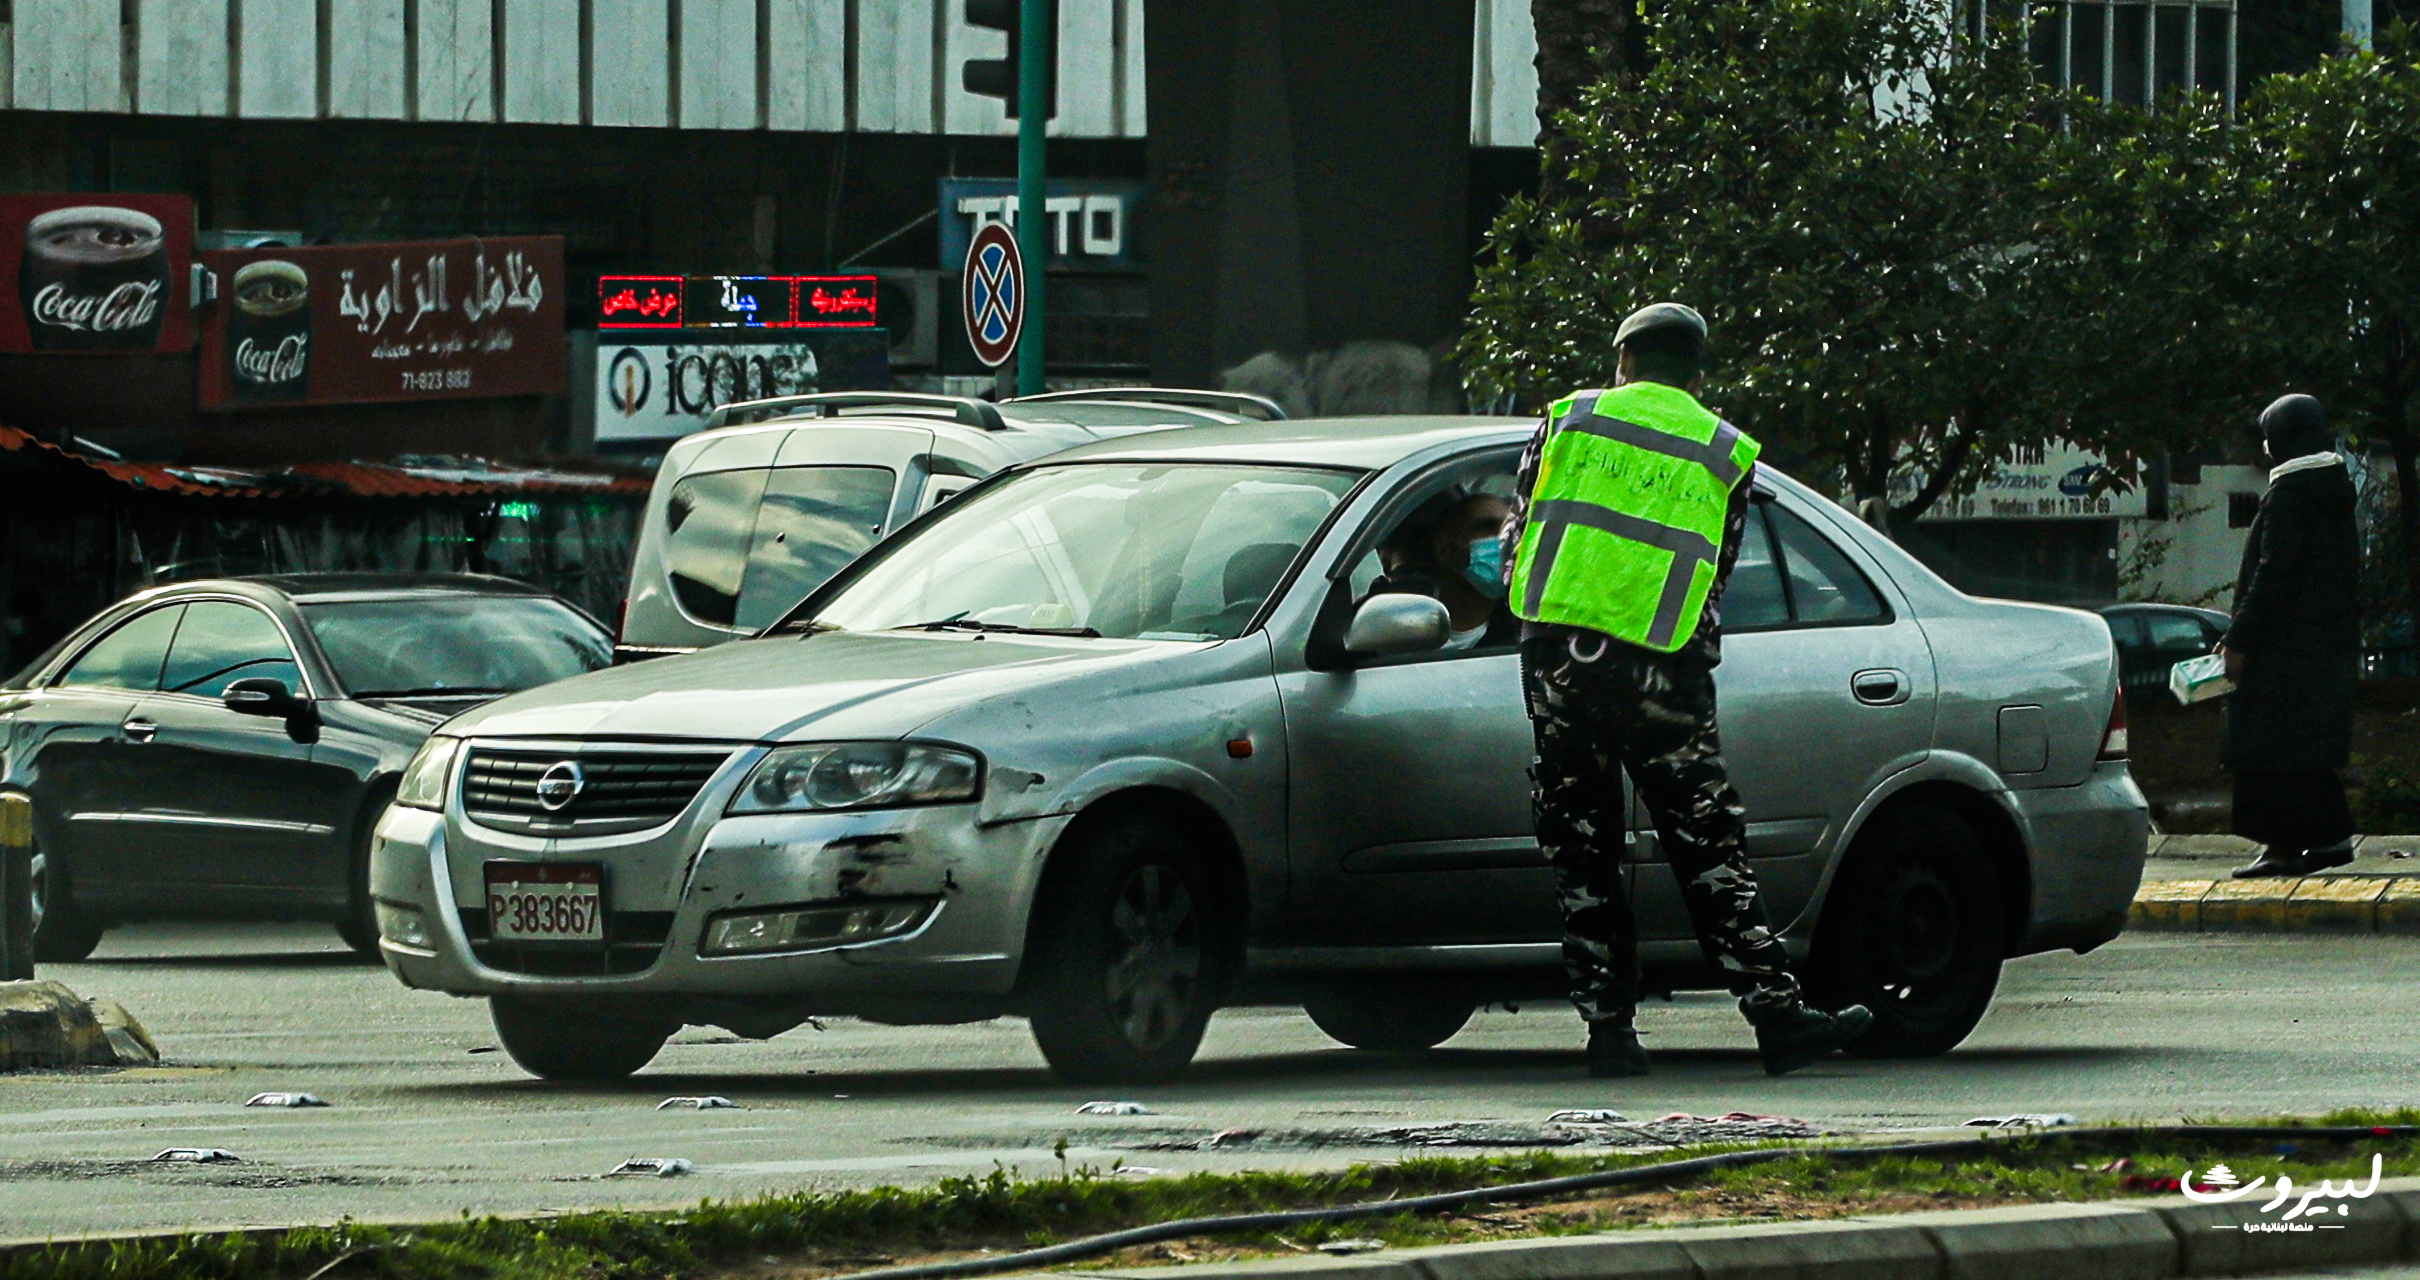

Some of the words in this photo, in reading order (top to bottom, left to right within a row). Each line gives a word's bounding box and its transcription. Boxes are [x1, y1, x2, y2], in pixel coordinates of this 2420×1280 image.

[32, 279, 161, 331] Coca-Cola
[339, 254, 450, 335] الزاوية
[463, 251, 543, 322] فلافل
[640, 288, 677, 317] عرض
[236, 332, 307, 382] Coca-Cola
[490, 894, 599, 934] P383667
